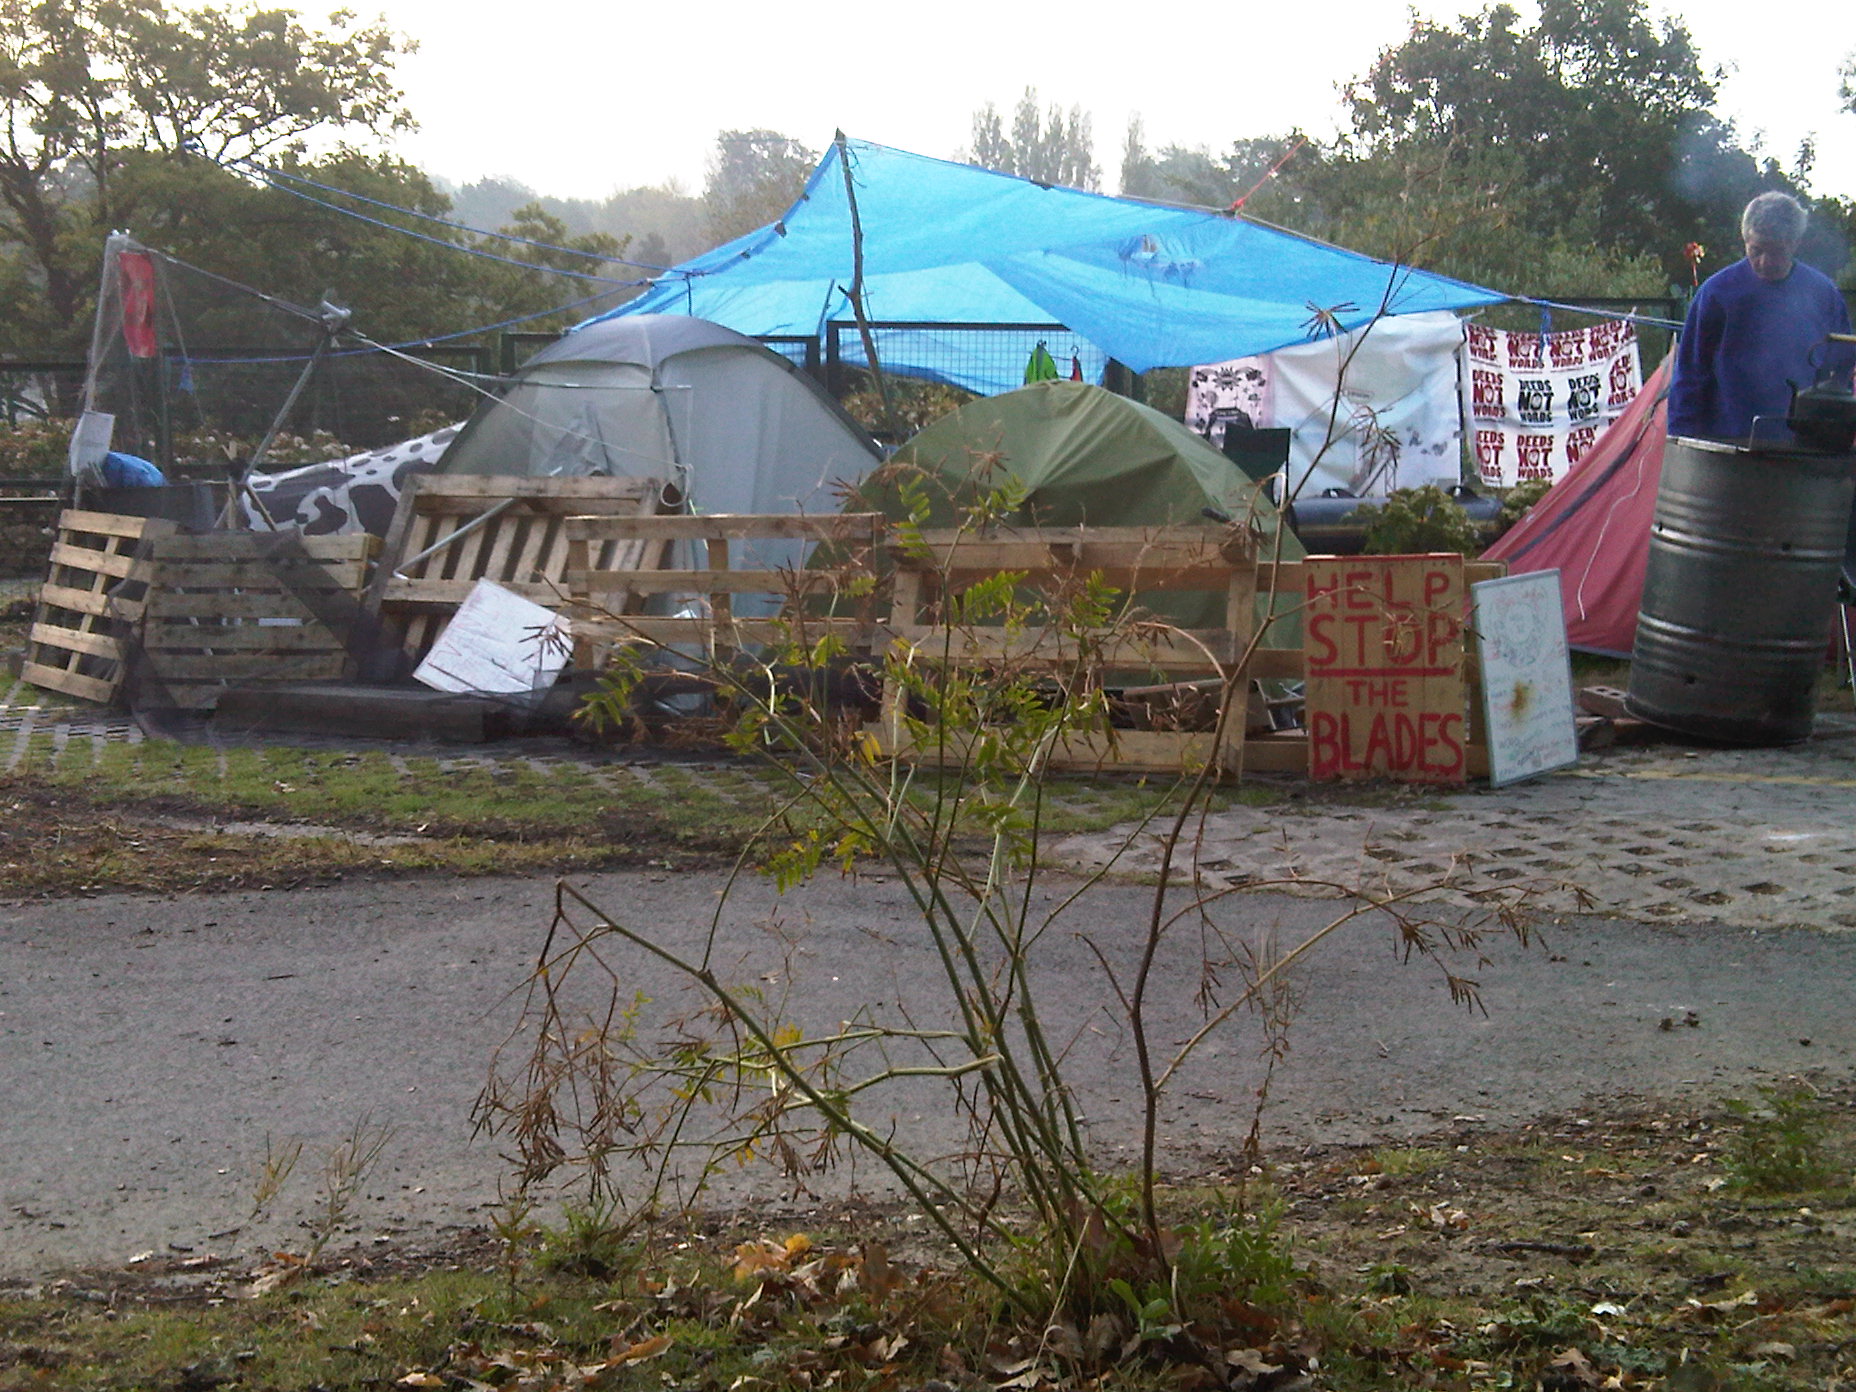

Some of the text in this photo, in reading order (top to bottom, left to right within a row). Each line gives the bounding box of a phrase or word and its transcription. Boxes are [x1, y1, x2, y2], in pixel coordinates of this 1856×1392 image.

[1507, 339, 1541, 357] NOT
[1550, 339, 1585, 357] NOT
[1509, 358, 1545, 369] WORDS
[1472, 369, 1504, 385] DEEDS
[1473, 383, 1503, 405] NOT
[1518, 391, 1554, 412] NOT
[1567, 384, 1602, 411] NOT
[1473, 404, 1506, 418] WORDS
[1520, 412, 1553, 423] WORDS
[1517, 434, 1554, 447] DEEDS
[1517, 447, 1553, 467] NOT
[1518, 467, 1554, 480] WORDS
[1307, 570, 1450, 611] HELP
[1308, 612, 1461, 667] STOP
[1346, 679, 1409, 707] THE
[1312, 711, 1464, 780] BLADES
